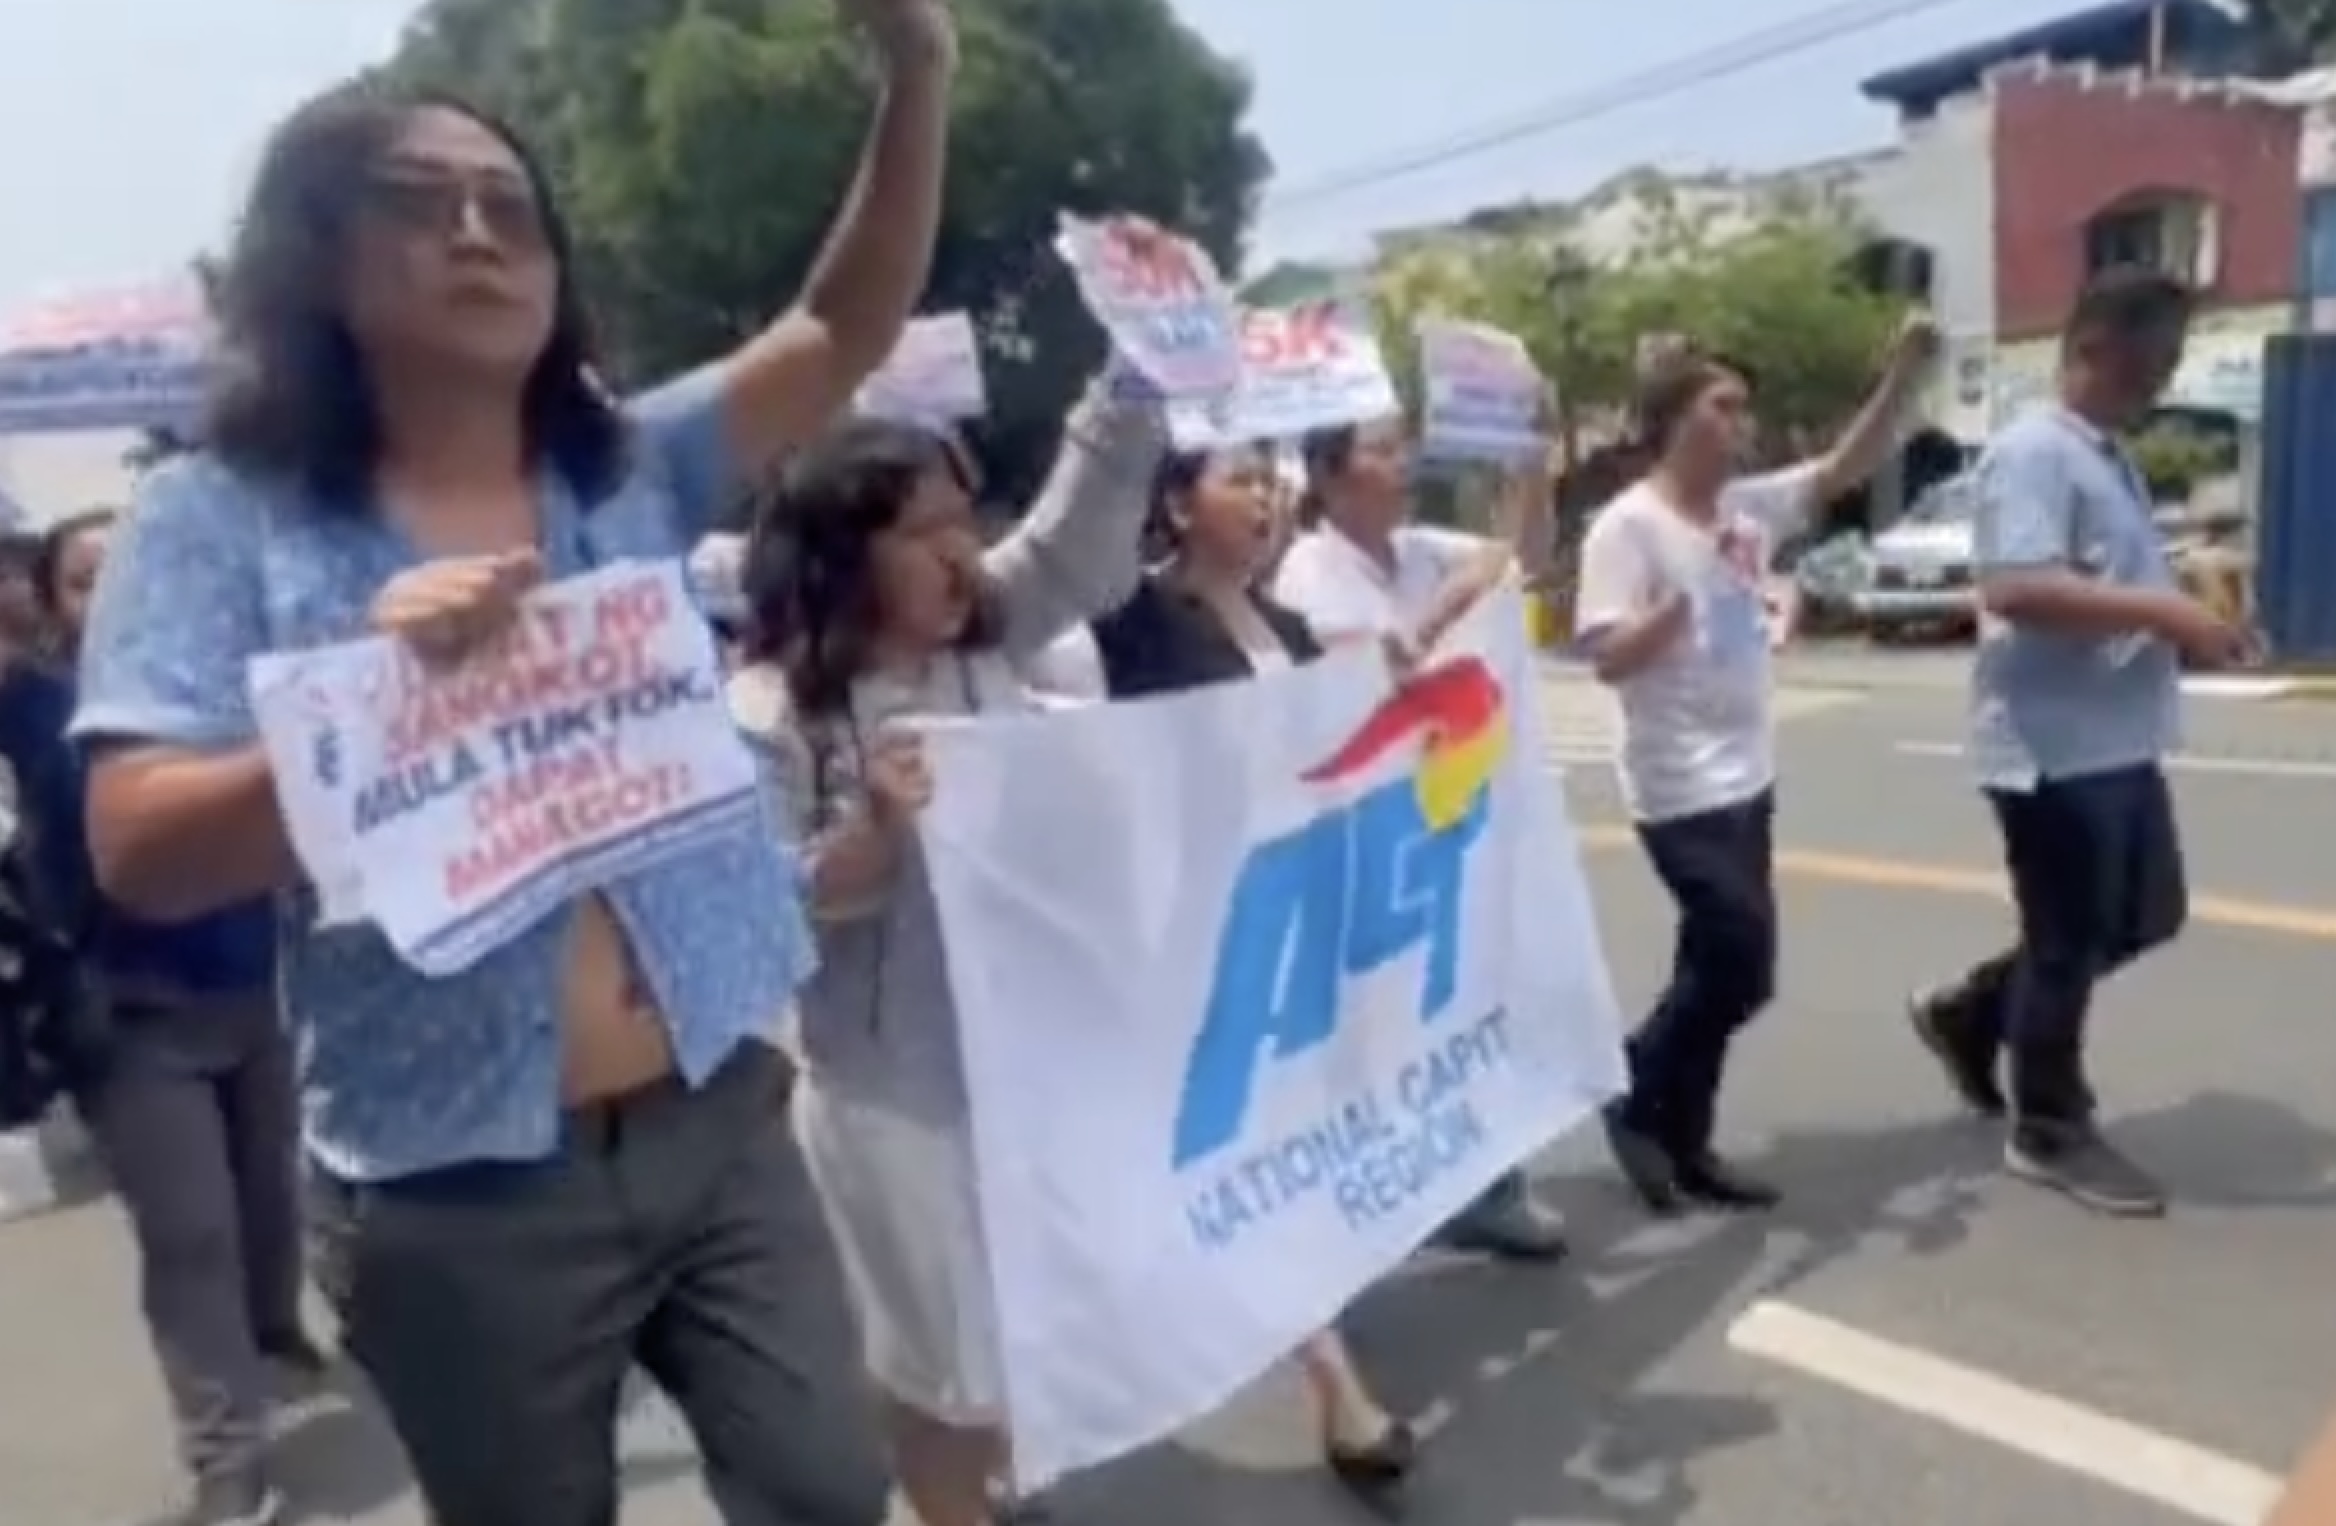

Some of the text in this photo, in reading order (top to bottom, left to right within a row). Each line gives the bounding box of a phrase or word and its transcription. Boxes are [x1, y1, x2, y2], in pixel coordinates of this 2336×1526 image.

[354, 737, 482, 834] MULA
[1186, 1088, 1396, 1247] NATIONAL
[1335, 1098, 1483, 1232] REGION
